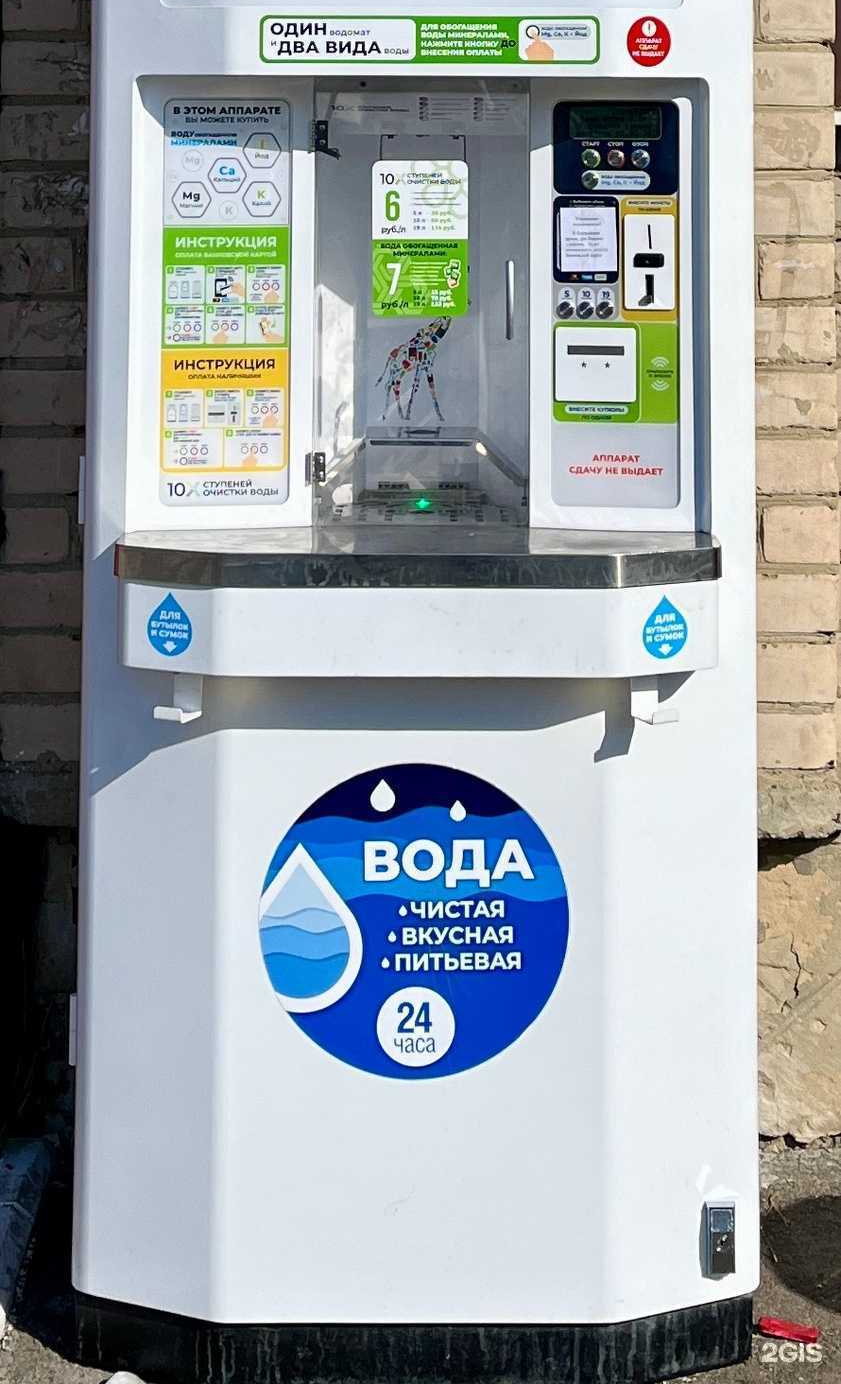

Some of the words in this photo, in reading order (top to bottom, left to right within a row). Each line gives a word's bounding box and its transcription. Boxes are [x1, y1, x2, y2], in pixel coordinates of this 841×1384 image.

[270, 23, 327, 37] ОДИН
[421, 23, 439, 31] ДЛЯ
[440, 23, 497, 31] ОБОГАЩЕНИЯ
[277, 41, 319, 56] ДВА
[326, 41, 381, 56] ВИДА
[500, 39, 517, 48] ДО
[173, 107, 181, 115] В
[183, 106, 216, 115] ЭТОМ
[220, 106, 281, 115] АППАРАТЕ
[219, 166, 235, 175] Ca
[183, 192, 200, 202] Mg
[257, 190, 265, 199] K
[386, 190, 400, 222] 6
[175, 236, 277, 249] ИНСТРУКЦИЯ
[387, 263, 401, 296] 7
[582, 290, 591, 298] 10
[174, 358, 275, 371] ИНСТРУКЦИЯ
[592, 454, 640, 463] АППАРАТ
[569, 467, 602, 476] СДАЧУ
[605, 467, 618, 475] НЕ
[621, 467, 663, 476] ВЫДАЕТ
[203, 479, 252, 488] СТУПЕНЕЙ
[250, 489, 278, 497] ВОДЫ
[160, 610, 181, 620] ДЛЯ
[654, 613, 676, 624] ДЛЯ
[151, 621, 189, 630] БУТЫЛОК
[363, 839, 535, 888] ВОДА
[410, 900, 505, 918] ЧИСТАЯ
[402, 926, 514, 945] ВКУСНАЯ
[395, 952, 522, 971] ПИТЬЕВАЯ
[397, 1001, 432, 1033] 24
[393, 1037, 436, 1053] часа
